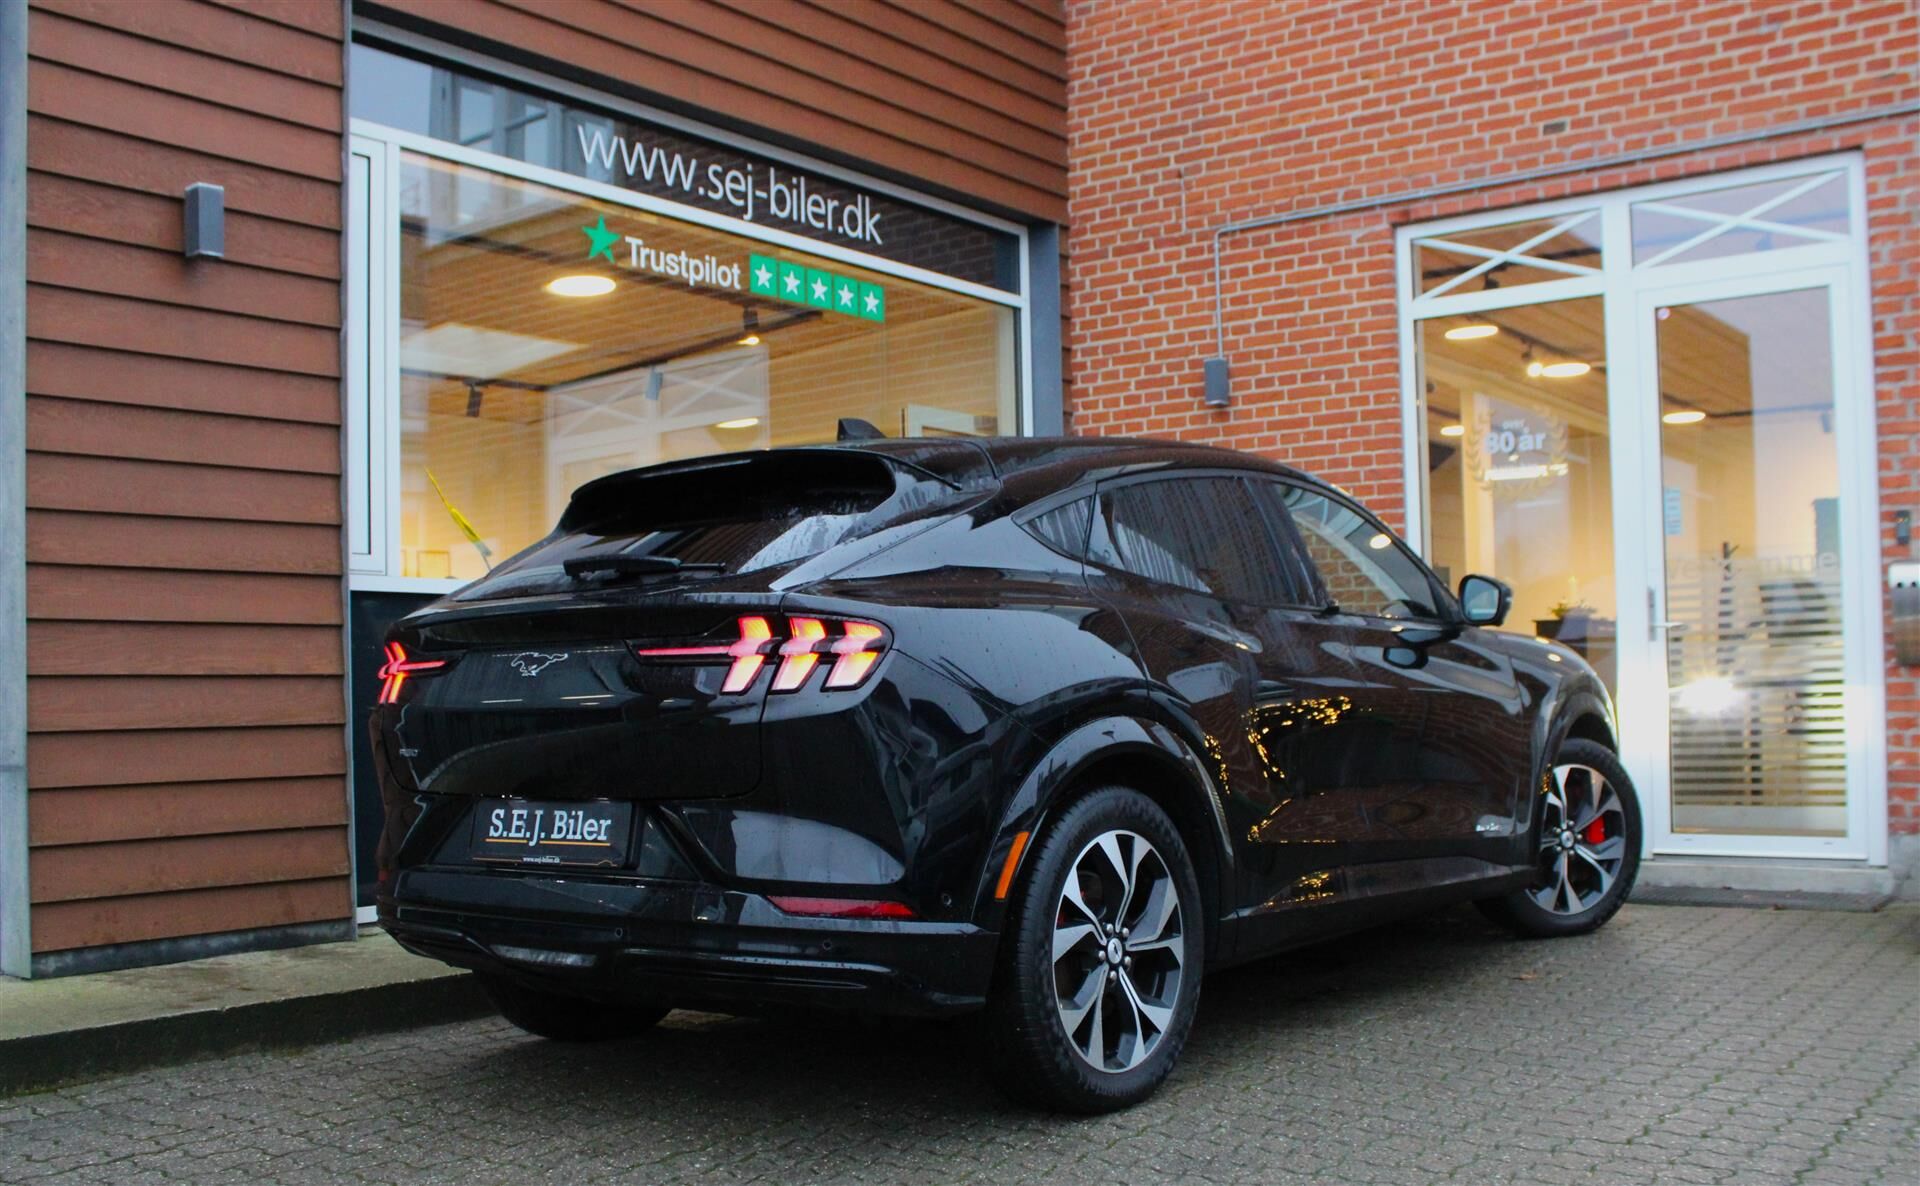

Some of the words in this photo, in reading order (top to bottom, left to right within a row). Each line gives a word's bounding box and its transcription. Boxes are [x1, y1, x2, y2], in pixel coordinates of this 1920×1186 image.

[577, 124, 883, 245] www.sej-biler.dk
[624, 236, 741, 290] Trustpilot
[1518, 424, 1547, 451] år
[488, 808, 546, 847] S.E.J.
[550, 809, 612, 841] Biler
